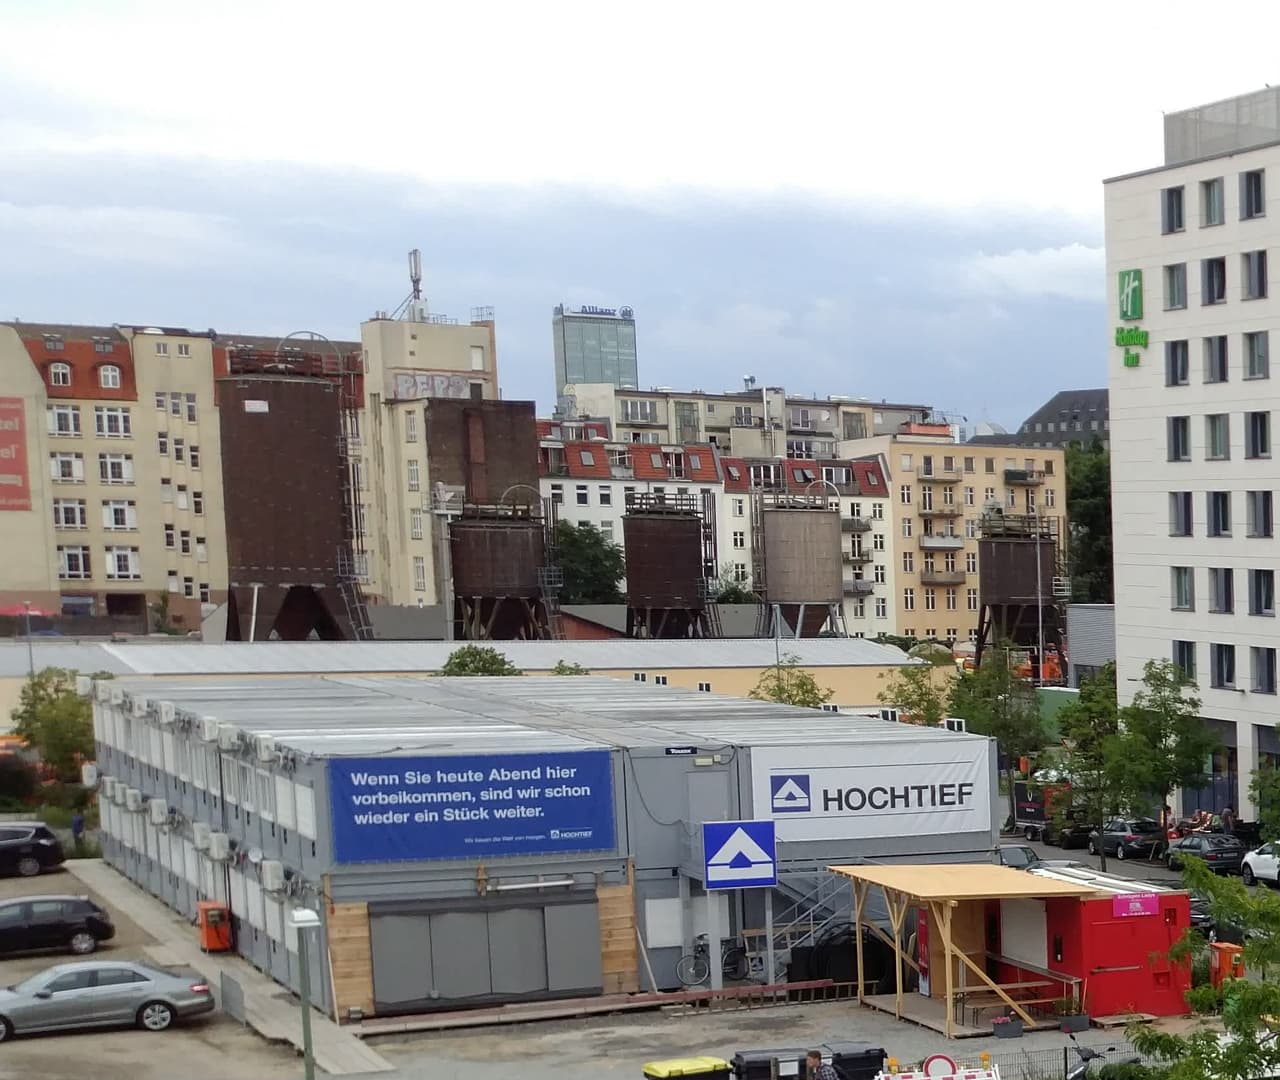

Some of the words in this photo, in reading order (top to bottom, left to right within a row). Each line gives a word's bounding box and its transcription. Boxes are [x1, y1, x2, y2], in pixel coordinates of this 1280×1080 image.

[581, 305, 617, 316] Allianz
[1115, 326, 1149, 349] Holiday
[1123, 348, 1140, 367] Inn
[351, 772, 399, 786] Wenn
[404, 771, 432, 785] Sie
[437, 770, 483, 783] heute
[489, 767, 541, 781] Abend
[546, 766, 577, 779] hier
[352, 790, 476, 805] vorbeikommen,
[480, 787, 513, 801] sind
[517, 786, 541, 799] wir
[545, 785, 591, 798] schon
[823, 783, 974, 811] HOCHTIEF
[354, 810, 410, 825] wieder
[414, 809, 439, 822] ein
[443, 807, 489, 821] Stück
[493, 805, 545, 819] weiter.
[561, 830, 592, 839] HOCHTIEF
